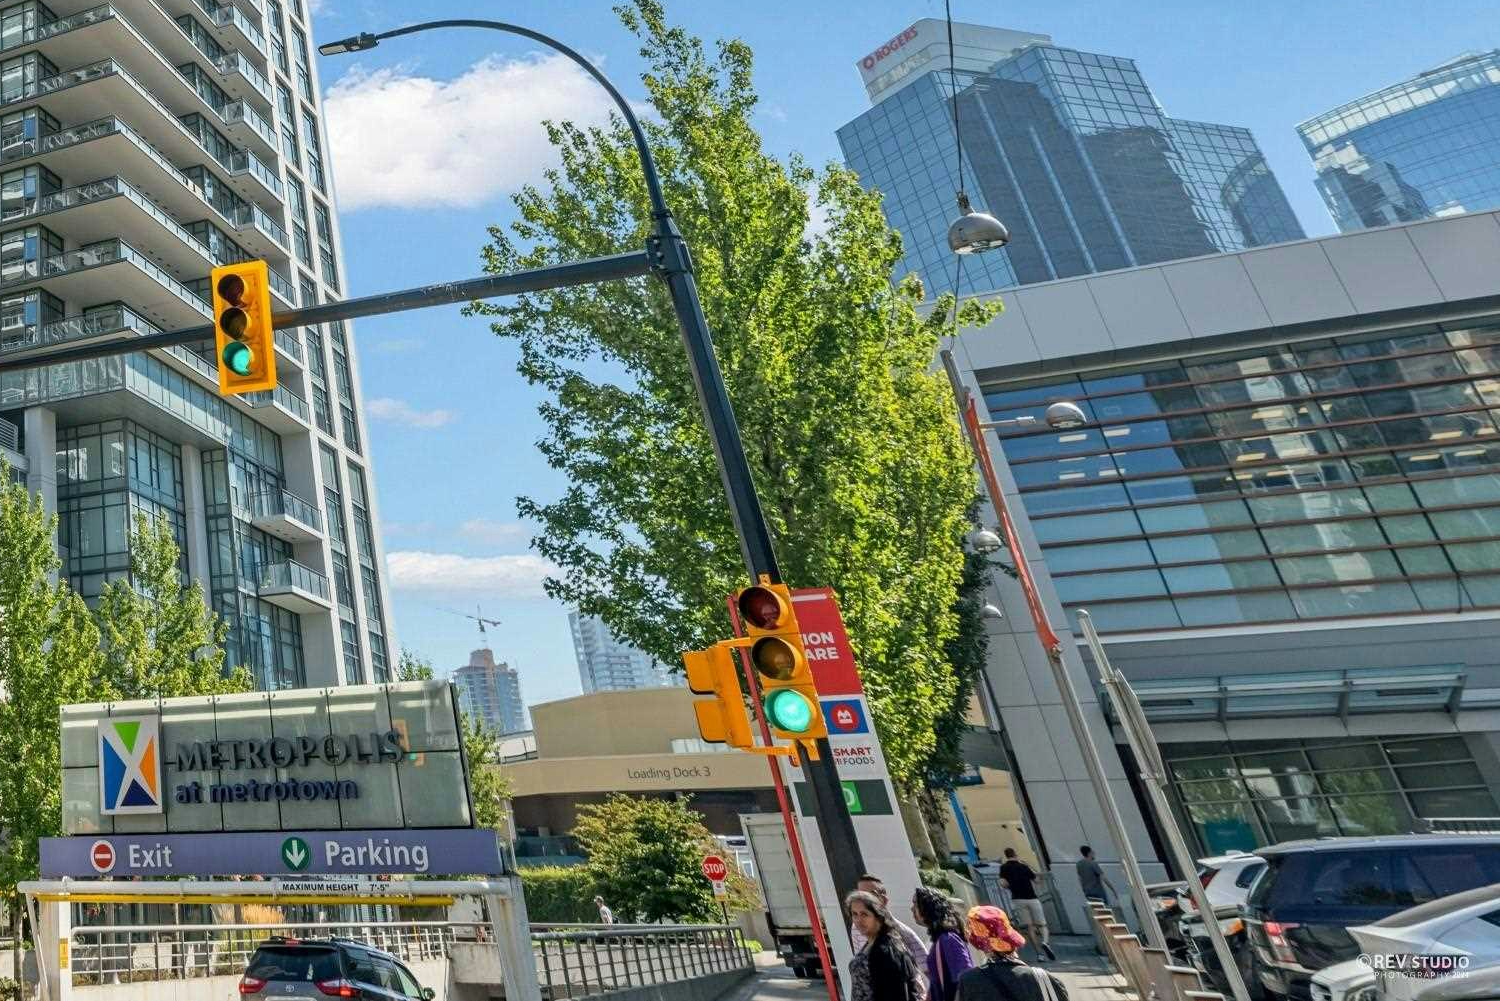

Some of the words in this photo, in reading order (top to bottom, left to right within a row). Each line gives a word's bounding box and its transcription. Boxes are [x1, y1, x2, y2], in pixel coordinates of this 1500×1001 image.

[876, 25, 917, 61] ROGERS
[804, 647, 840, 661] ARE
[175, 729, 406, 772] METROPOLIS
[627, 767, 671, 780] Loading
[673, 766, 702, 778] Dock
[703, 765, 711, 777] 3
[173, 781, 202, 804] at
[210, 777, 359, 803] metrotown
[129, 844, 173, 869] Exit
[325, 839, 429, 872] Parking
[703, 863, 725, 874] STOP
[282, 883, 324, 891] MAXIMUM
[326, 883, 359, 891] HEIGHT
